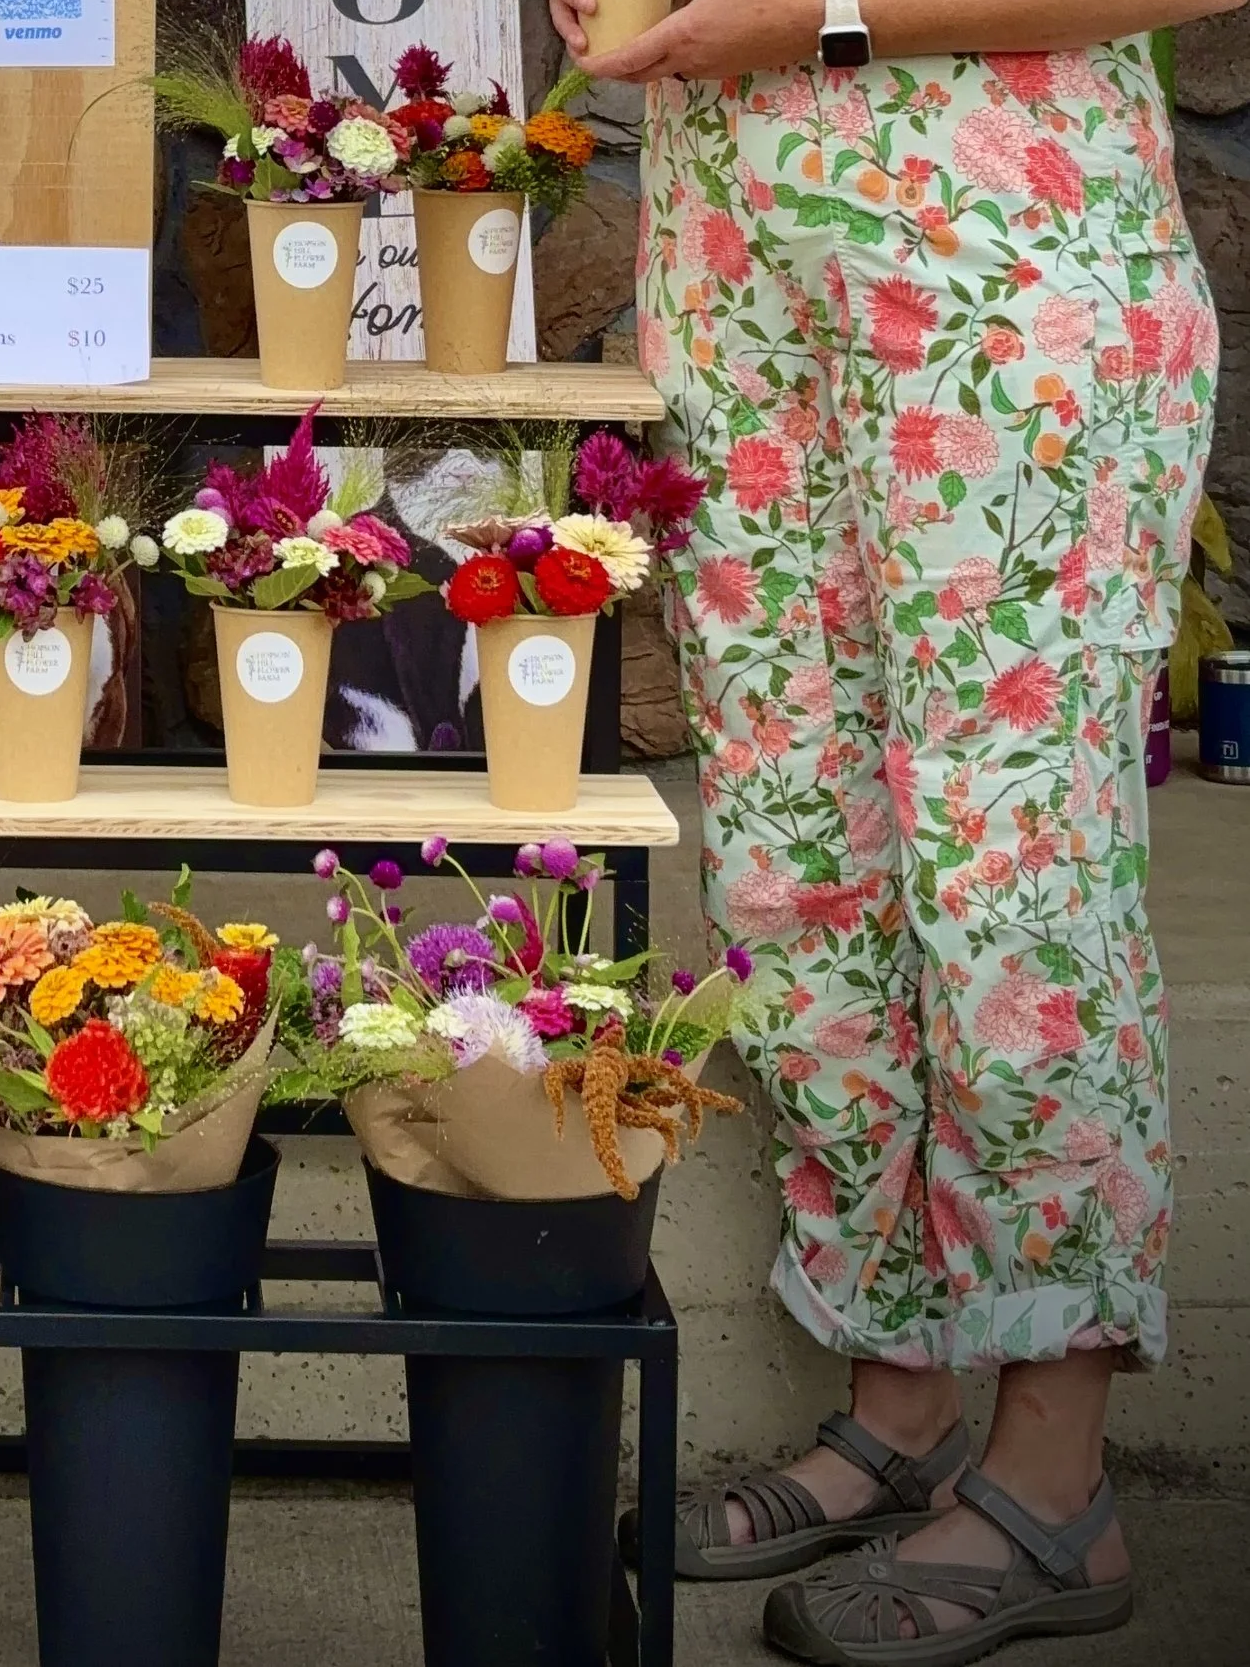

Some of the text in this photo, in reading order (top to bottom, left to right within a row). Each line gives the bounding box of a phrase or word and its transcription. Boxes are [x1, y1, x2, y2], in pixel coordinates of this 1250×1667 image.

[5, 26, 62, 40] venmo
[66, 277, 105, 295] $25
[68, 329, 106, 348] $10
